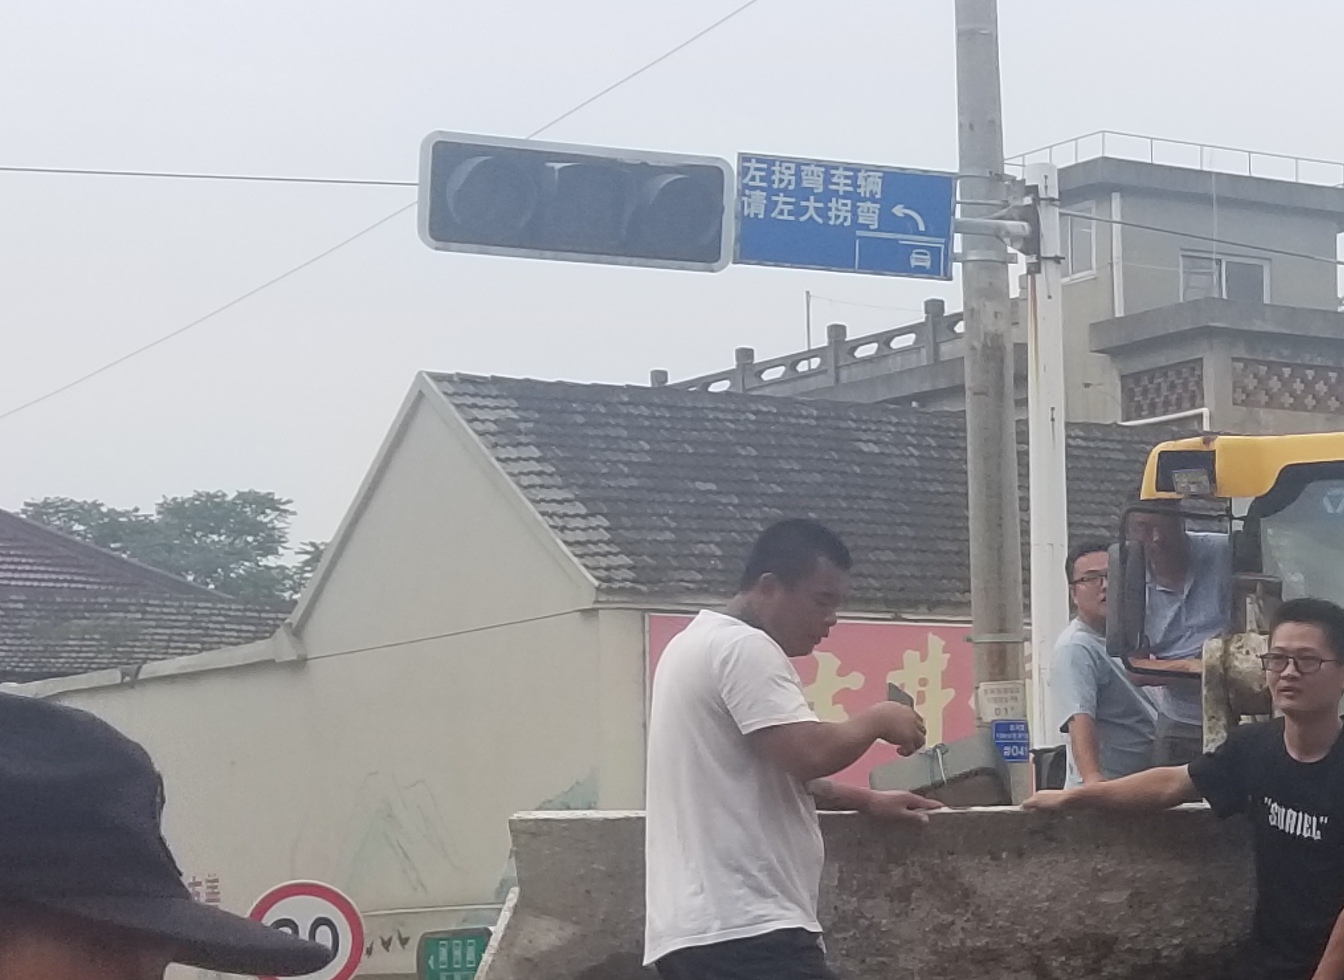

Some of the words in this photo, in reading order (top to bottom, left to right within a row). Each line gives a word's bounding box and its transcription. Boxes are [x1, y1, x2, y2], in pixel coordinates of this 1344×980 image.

[742, 159, 883, 199] 左拐弯车辆
[744, 190, 881, 230] 请左大拐弯
